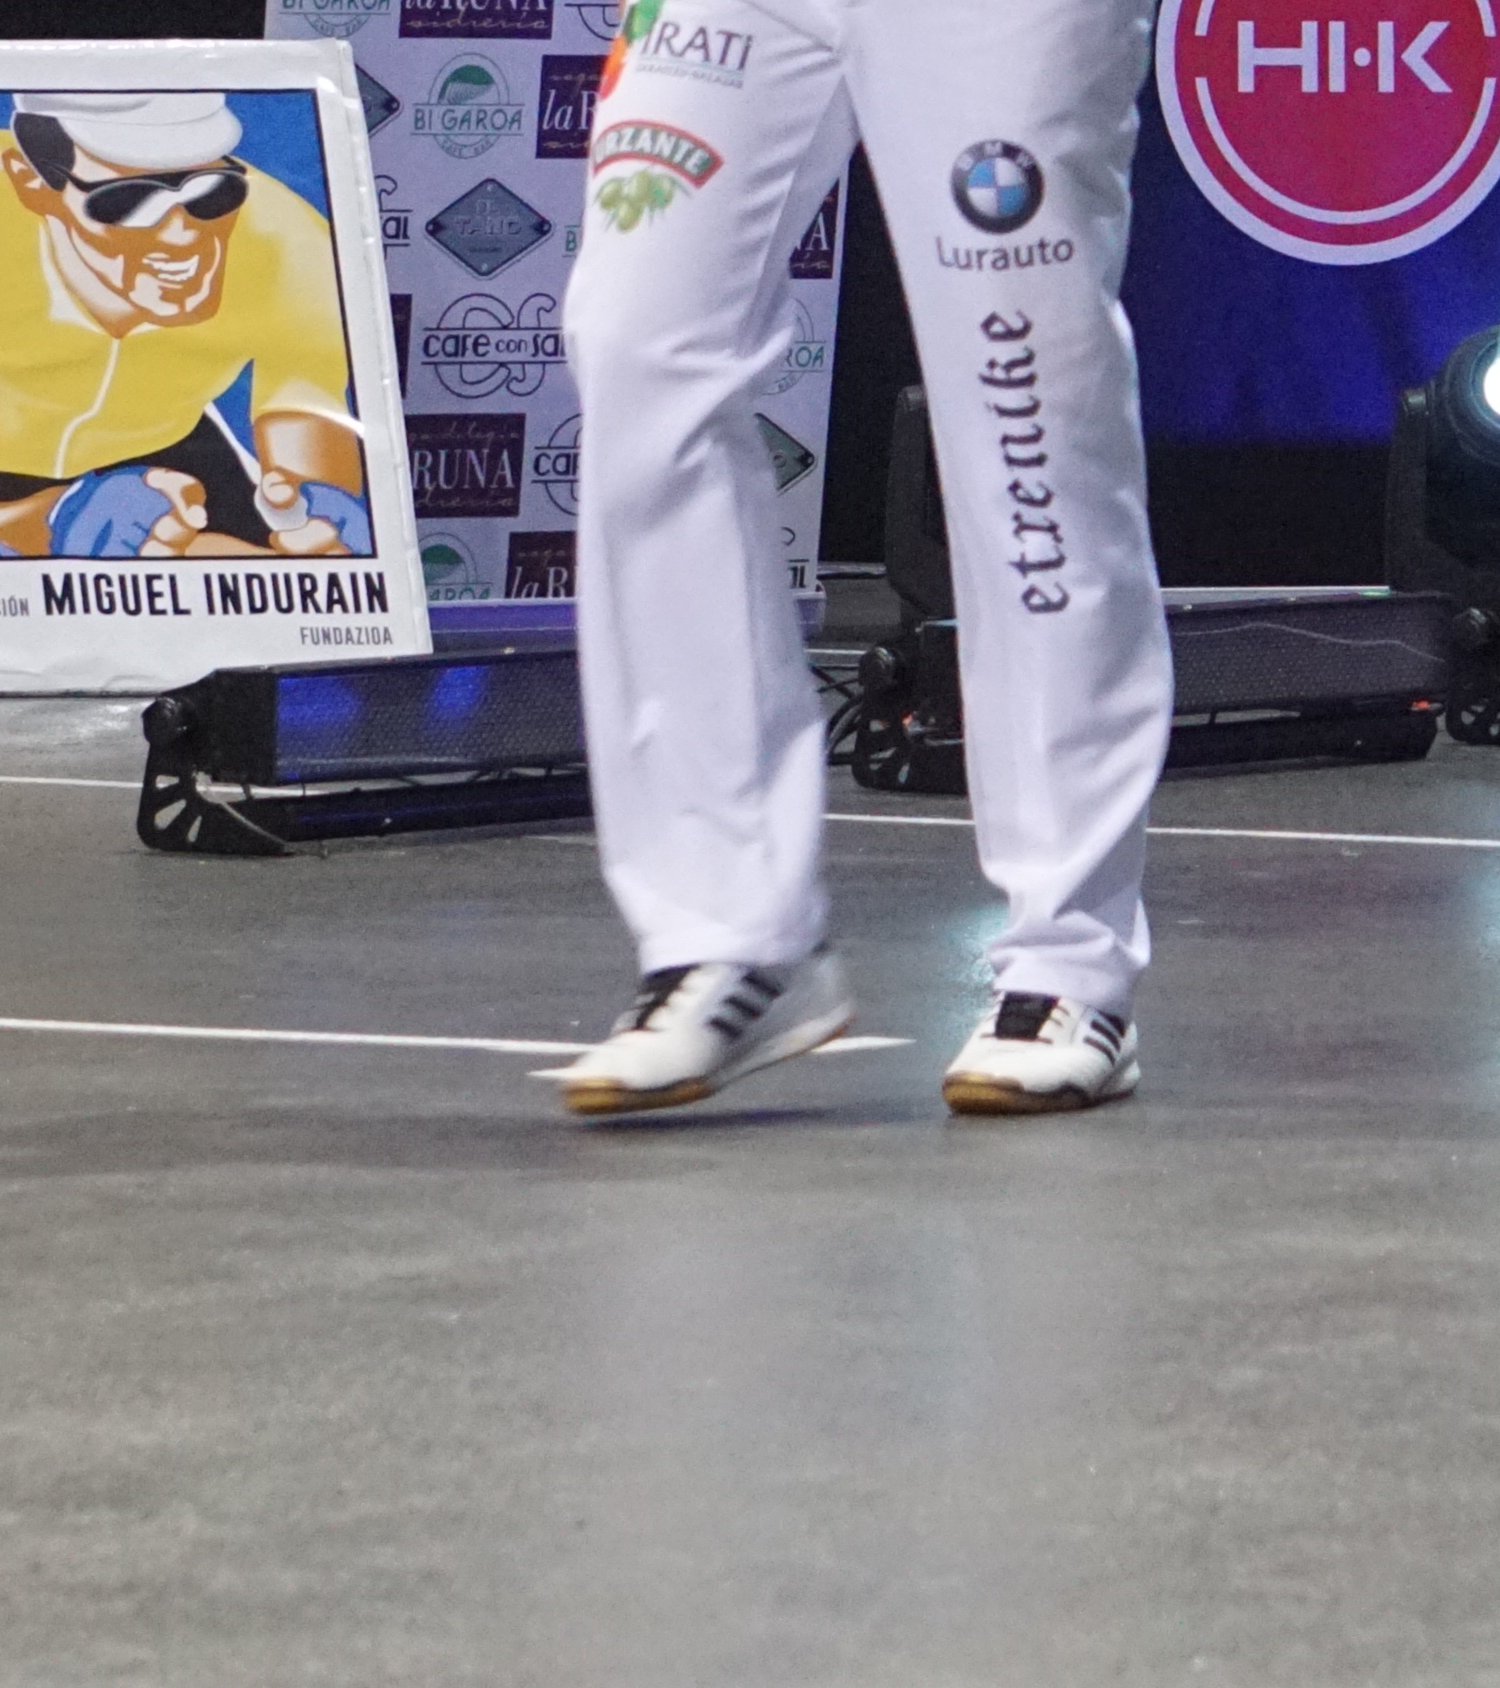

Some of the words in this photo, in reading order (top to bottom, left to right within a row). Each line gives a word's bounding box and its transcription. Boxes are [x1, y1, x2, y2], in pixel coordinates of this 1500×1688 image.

[414, 109, 432, 130] BI
[442, 108, 522, 131] GAROA
[934, 235, 1075, 272] Lurauto
[495, 339, 527, 353] con
[413, 447, 516, 491] RUNA
[42, 571, 191, 617] MIGUEL
[204, 570, 389, 615] INDURAIN
[299, 624, 394, 647] FUNDAZIOA
